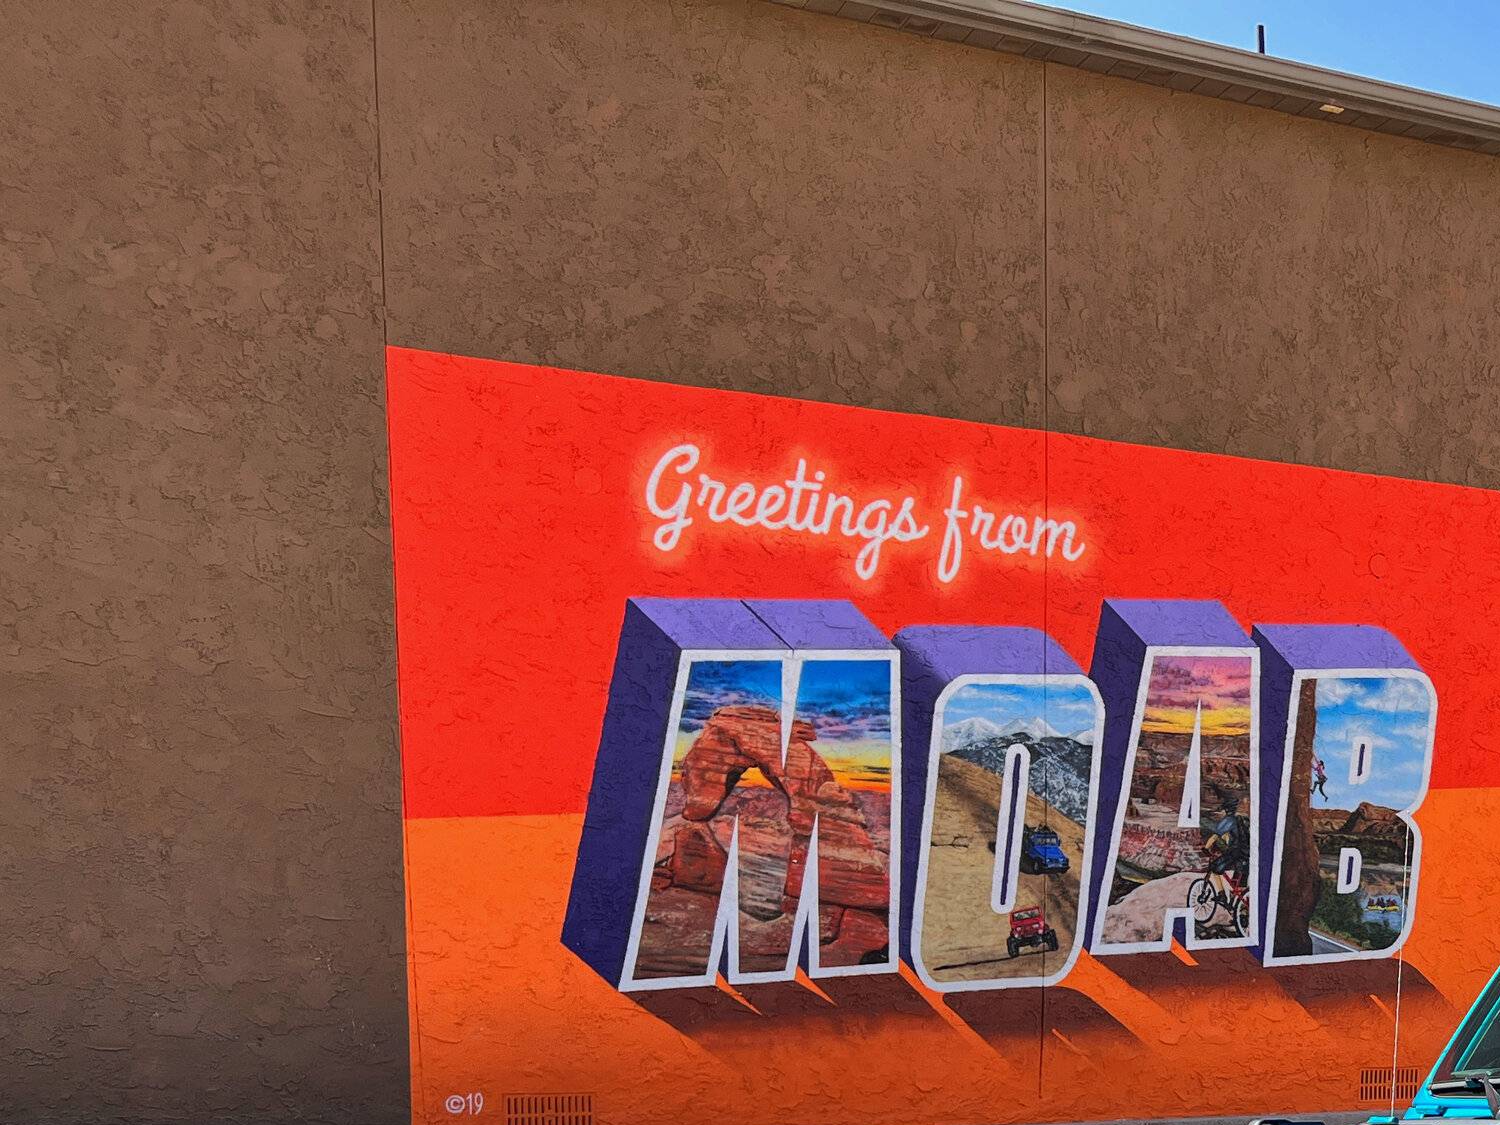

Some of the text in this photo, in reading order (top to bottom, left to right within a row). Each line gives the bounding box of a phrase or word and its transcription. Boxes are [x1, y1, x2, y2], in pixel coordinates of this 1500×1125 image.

[645, 443, 1086, 583] Greetings from
[562, 600, 1439, 993] MOAB
